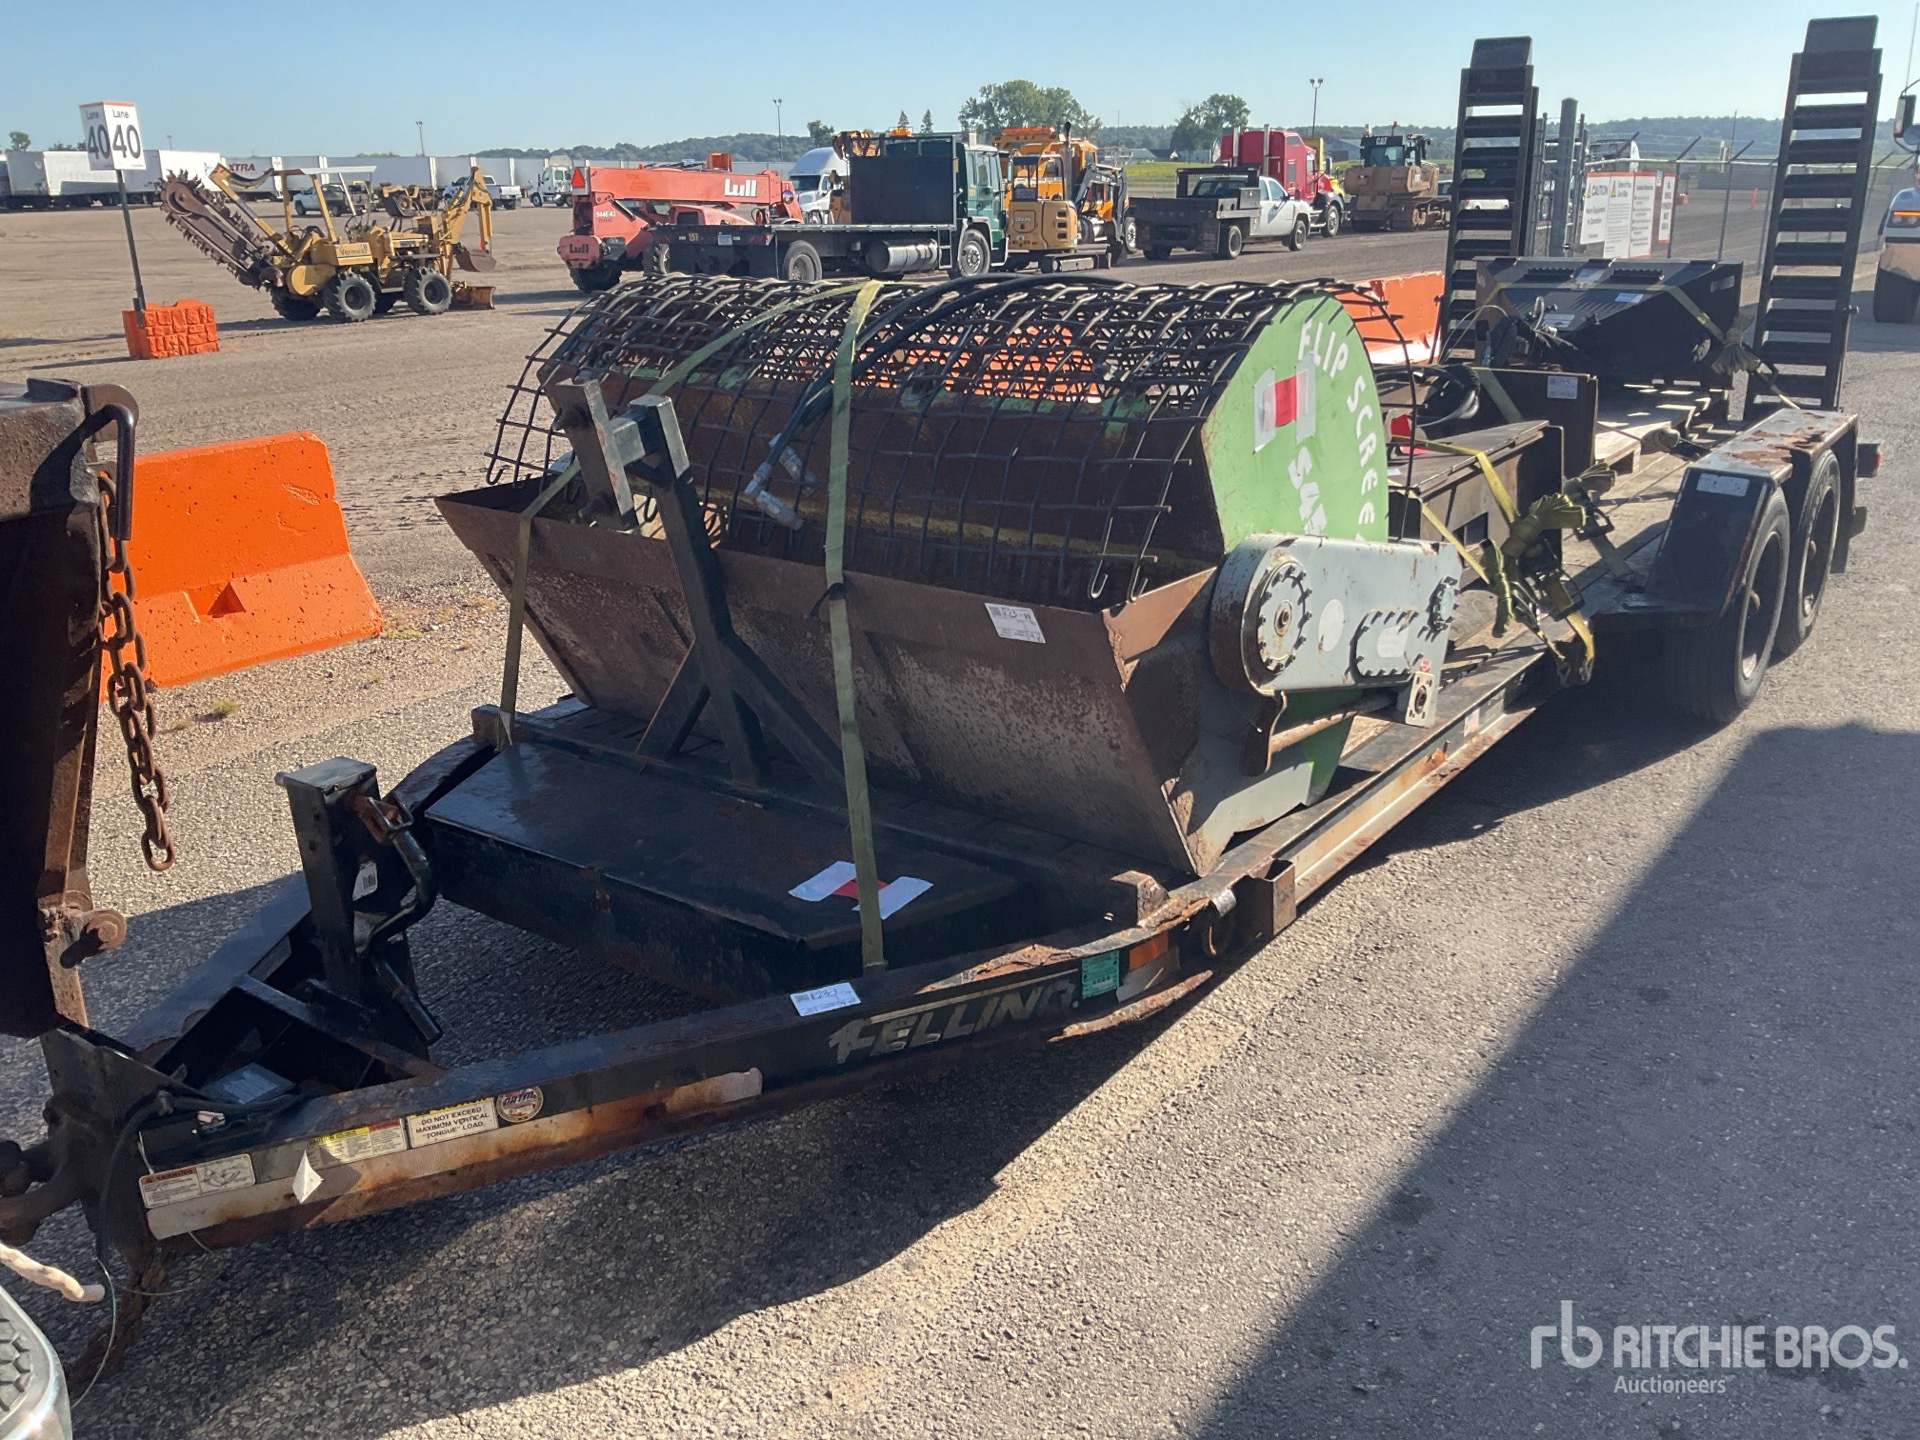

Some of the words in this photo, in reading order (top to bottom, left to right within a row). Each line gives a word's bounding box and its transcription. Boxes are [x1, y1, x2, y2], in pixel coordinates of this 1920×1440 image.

[86, 111, 99, 120] Lane
[112, 109, 129, 119] Lane
[88, 123, 111, 160] 40
[112, 124, 141, 159] 40
[1376, 137, 1388, 145] CAT
[229, 163, 256, 172] XTRA
[724, 178, 757, 197] Lull
[569, 243, 590, 254] Lull
[1298, 318, 1349, 380] FLIP
[1346, 375, 1379, 542] SCREE
[415, 1121, 452, 1133] MAXIMUM
[453, 1112, 490, 1126] VERTICAL
[421, 1117, 432, 1126] DO
[433, 1115, 449, 1123] NOT
[451, 1106, 482, 1118] EXCEED
